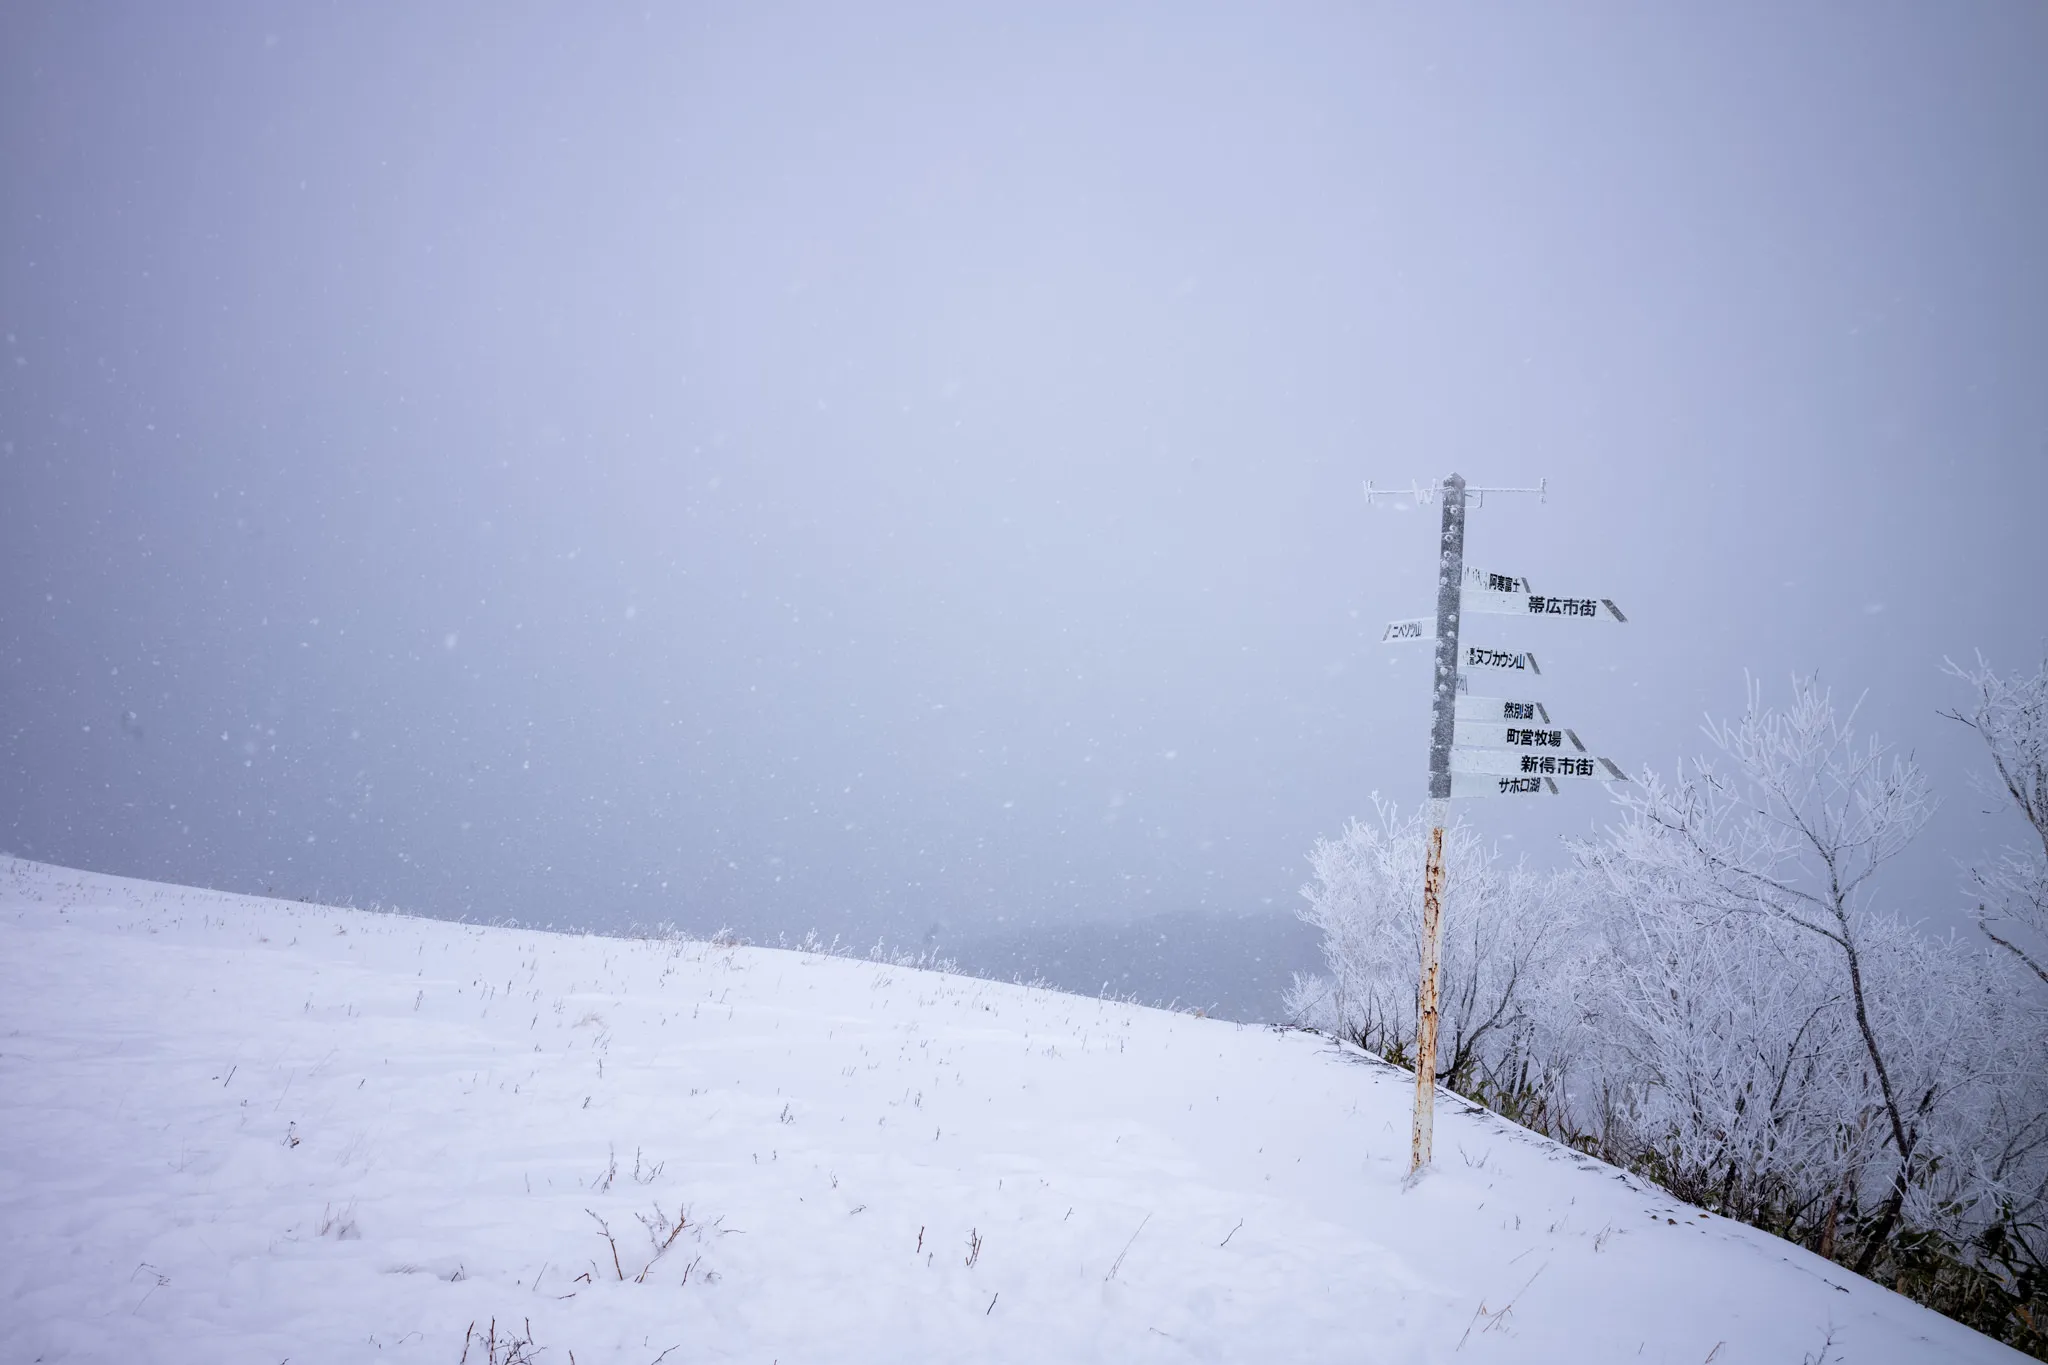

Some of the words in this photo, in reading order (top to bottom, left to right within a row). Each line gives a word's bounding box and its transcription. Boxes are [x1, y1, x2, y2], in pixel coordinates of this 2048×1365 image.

[1528, 595, 1597, 617] 帯広市街
[1503, 702, 1534, 720] 然別湖
[1506, 728, 1562, 747] 町営牧場
[1521, 755, 1594, 776] 新得市街
[1499, 777, 1541, 794] サホロ湖
